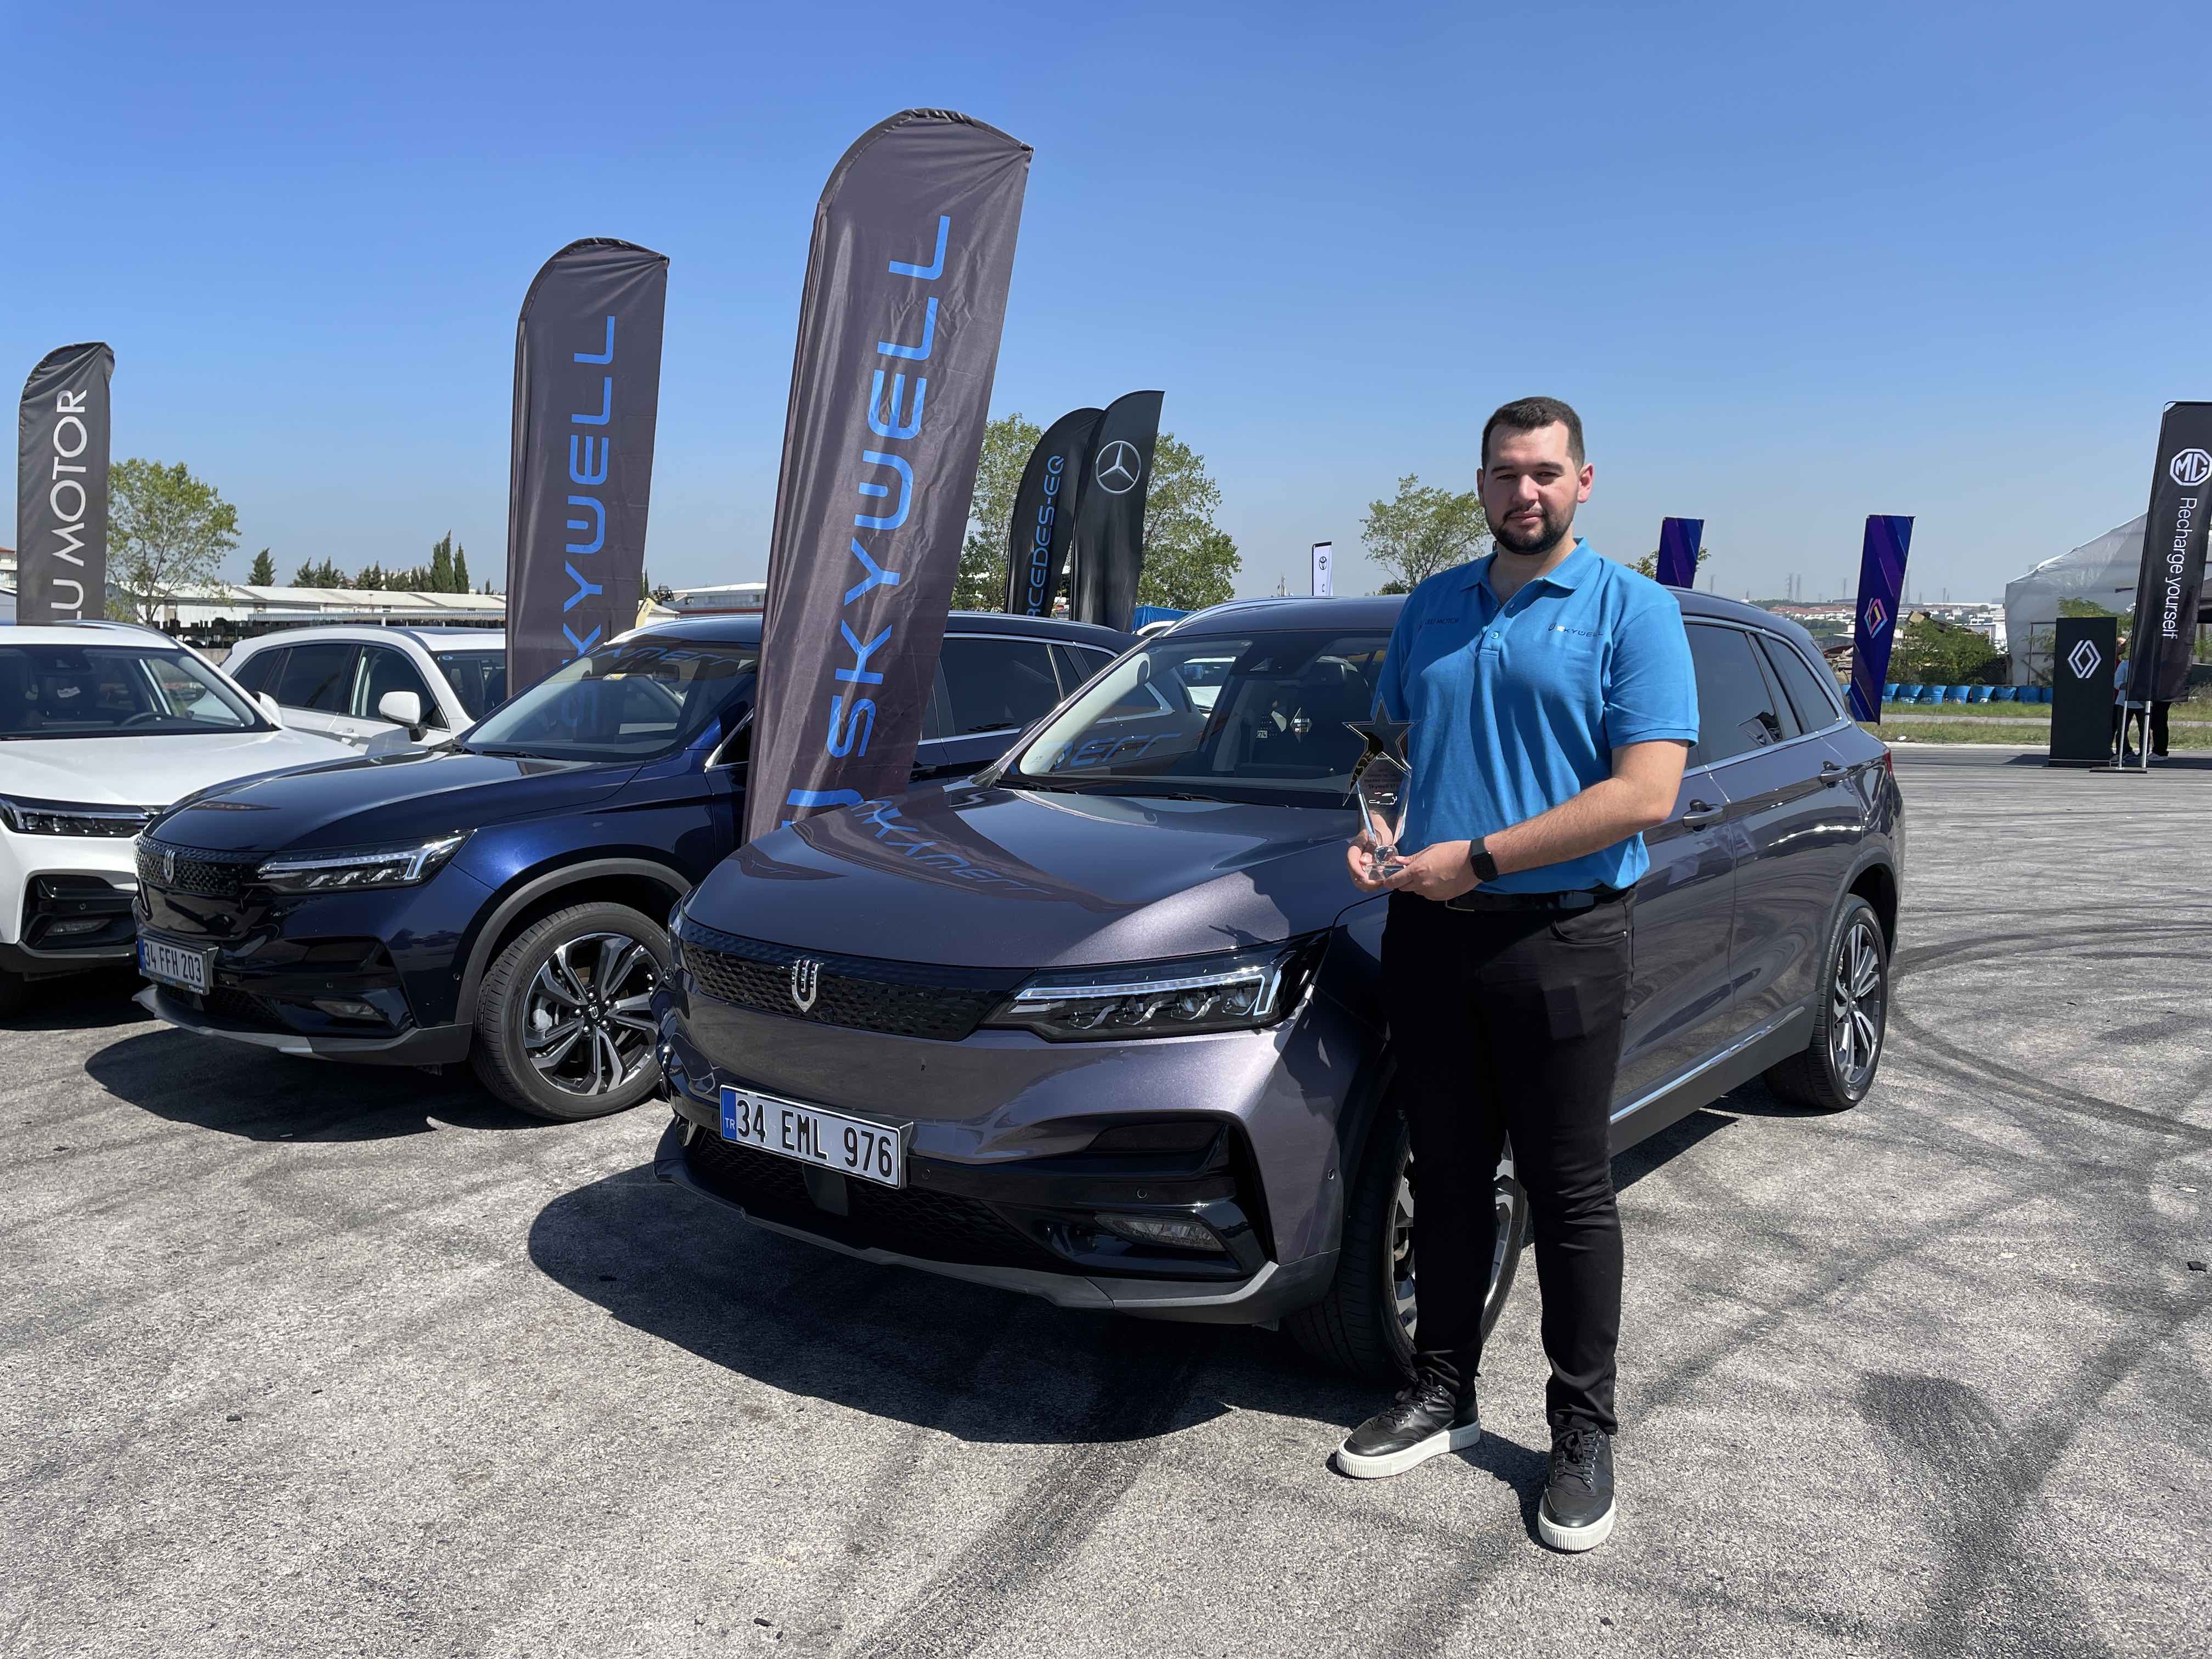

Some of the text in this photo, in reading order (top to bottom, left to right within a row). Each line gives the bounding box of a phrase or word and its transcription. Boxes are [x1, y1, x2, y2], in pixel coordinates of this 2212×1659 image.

[50, 389, 87, 567] MOTOR
[561, 315, 615, 666] KYWELL
[827, 215, 951, 759] SKYWELL
[2173, 451, 2209, 483] MG
[2162, 497, 2198, 640] Recharge yourself
[144, 942, 201, 983] 34 FFH 203
[725, 1099, 892, 1177] TR 34 EML 976
